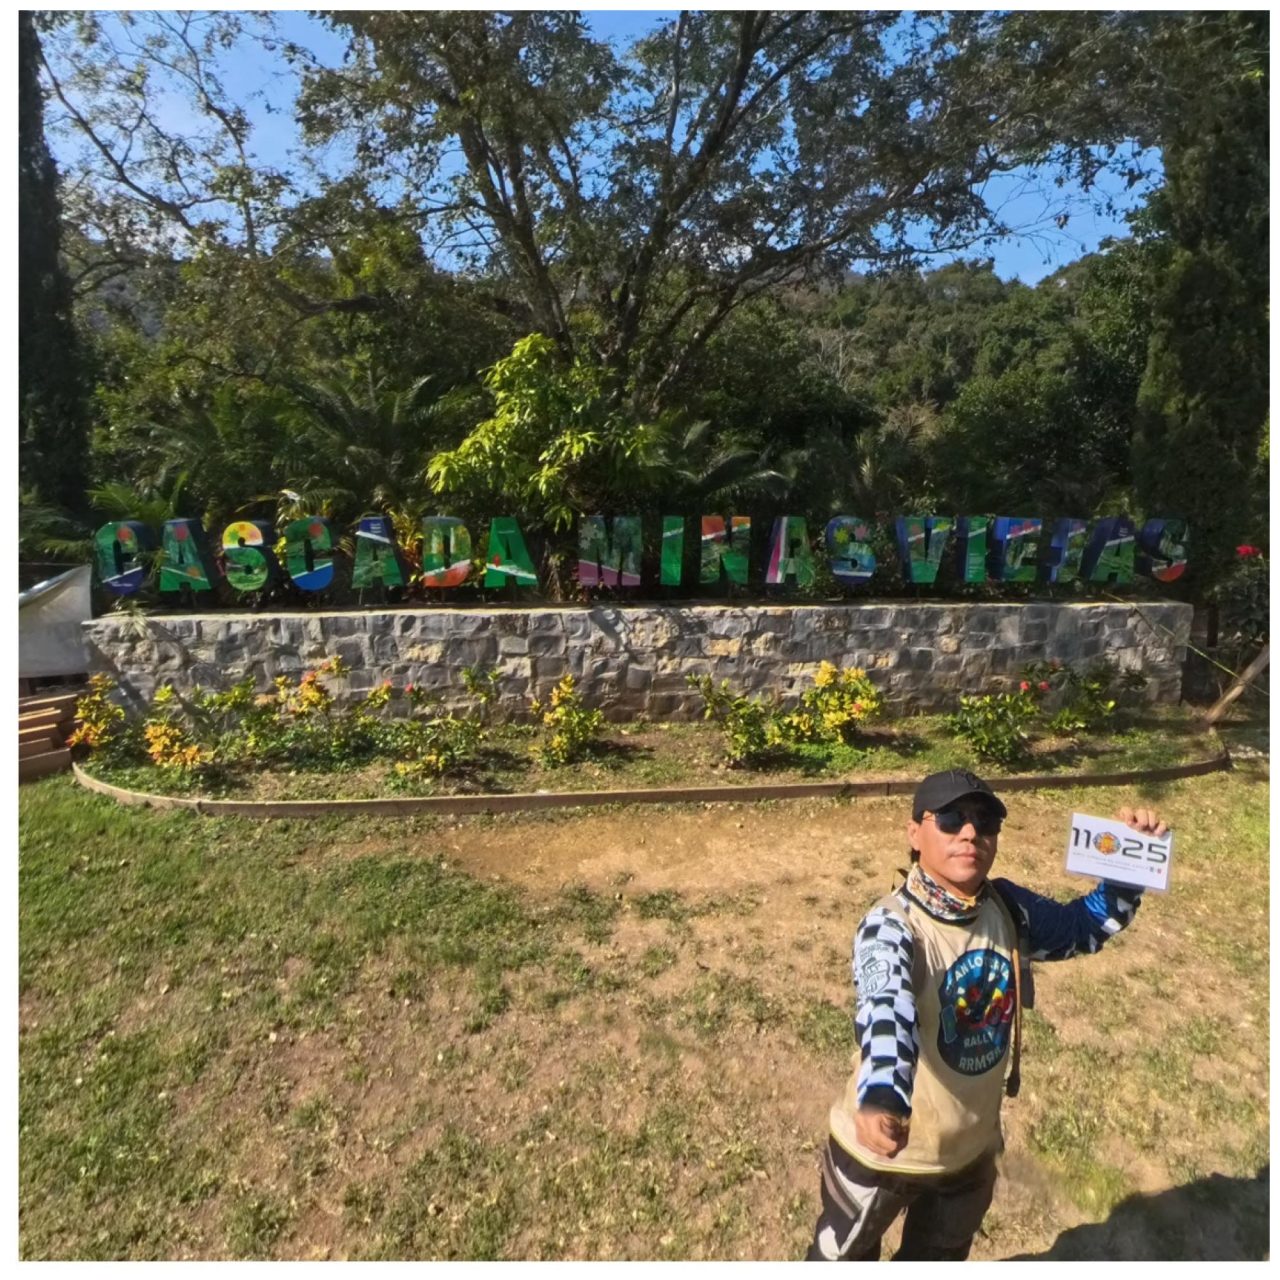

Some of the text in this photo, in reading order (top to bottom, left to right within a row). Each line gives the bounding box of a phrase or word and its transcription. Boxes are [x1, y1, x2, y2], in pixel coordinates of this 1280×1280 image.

[96, 515, 1189, 594] CASCADA MINAS VIEJAS
[963, 1026, 995, 1049] RALLY
